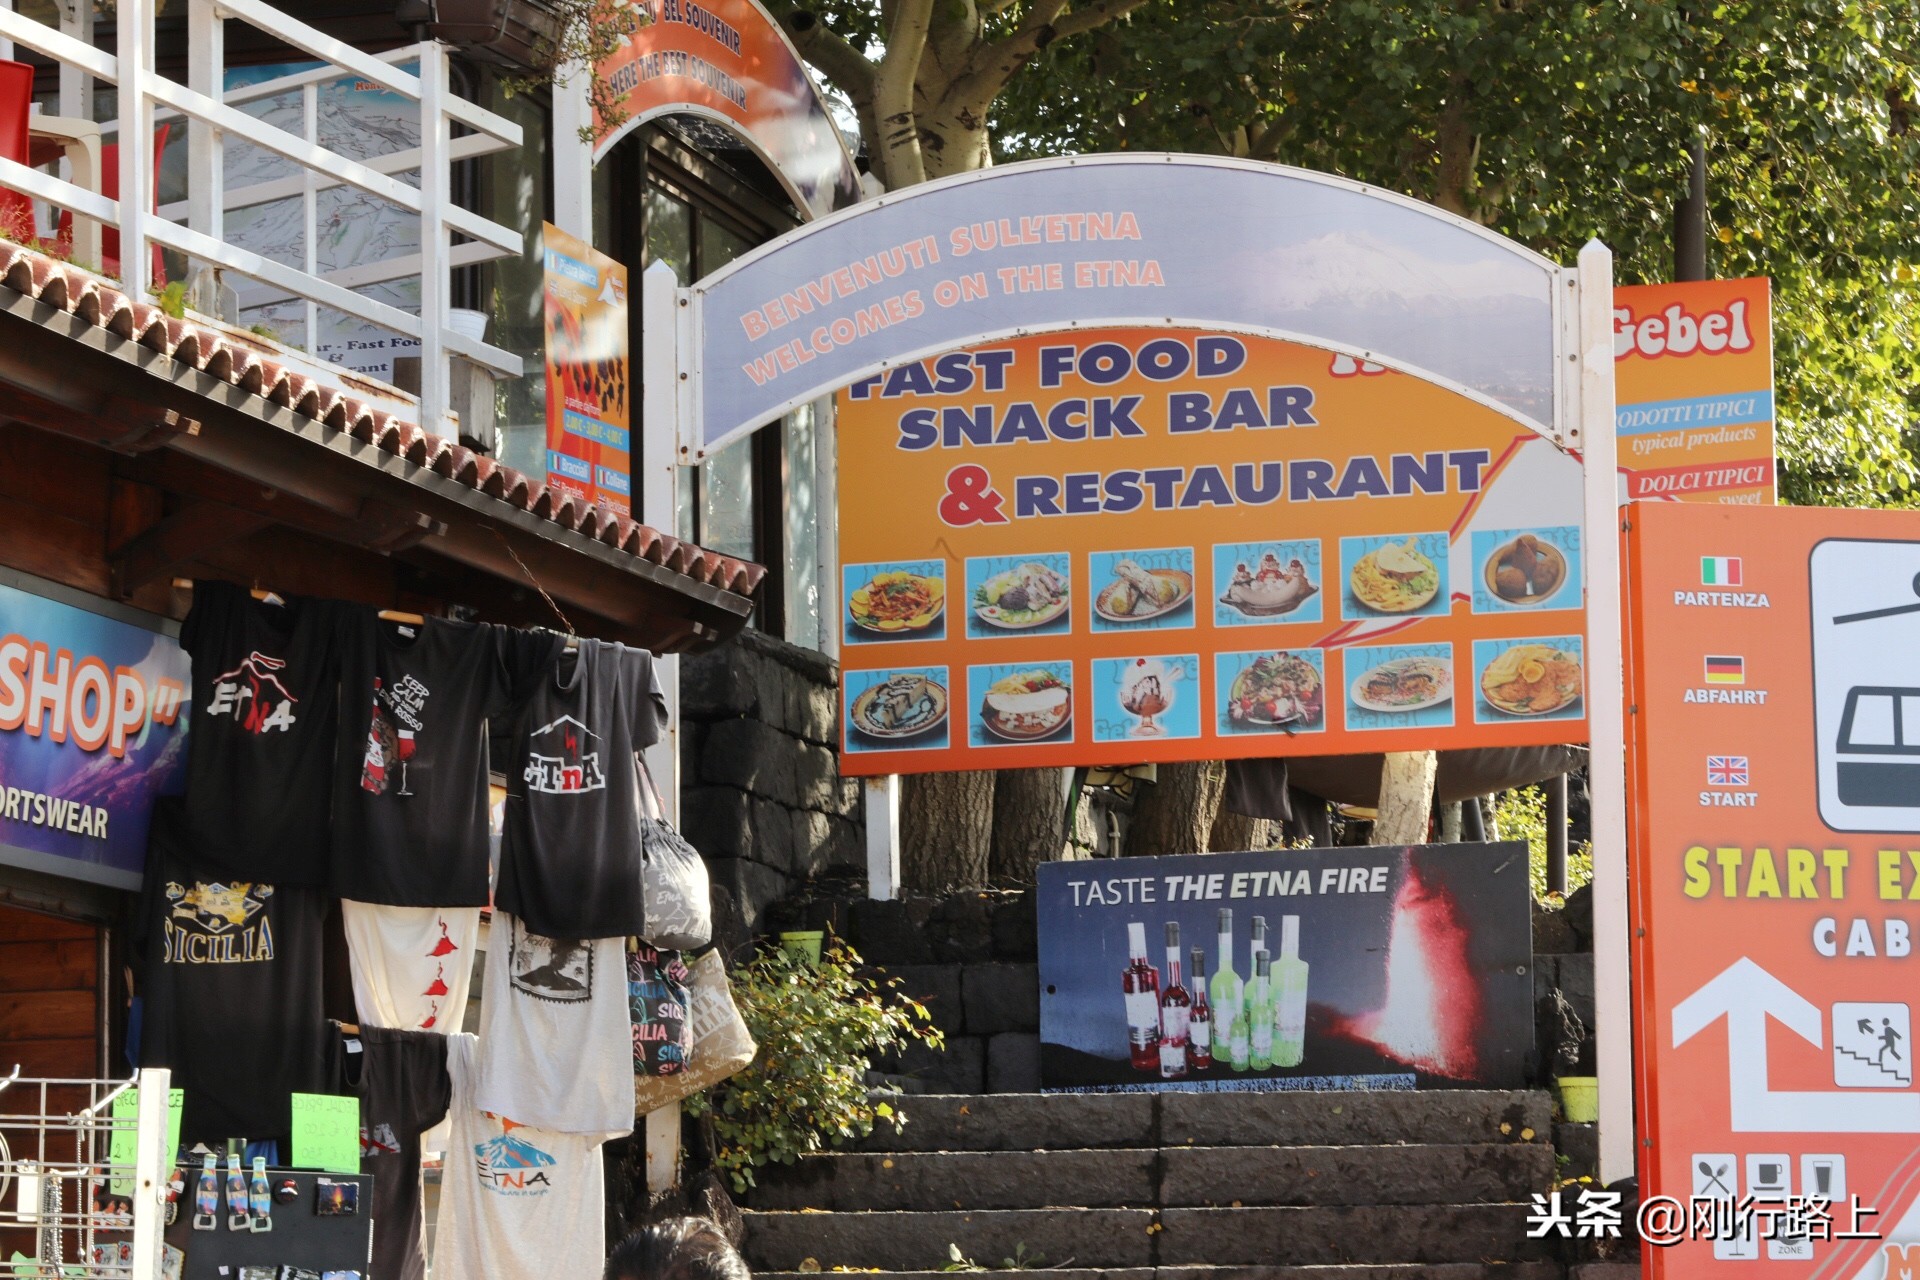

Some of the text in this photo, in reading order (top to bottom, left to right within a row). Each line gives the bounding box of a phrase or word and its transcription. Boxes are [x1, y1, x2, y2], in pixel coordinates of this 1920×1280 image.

[664, 0, 683, 23] BEL
[686, 1, 742, 58] SOUVENIR
[609, 50, 747, 112] HERE THE BEST SOUVENIR
[739, 211, 1142, 342] BENVENUTI SULL'ETNA
[741, 259, 1165, 387] WELCOMES ON THE ETNA
[347, 339, 386, 351] Fast
[391, 337, 422, 348] Foo
[1039, 336, 1247, 389] FOOD
[897, 385, 1319, 452] SNACK BAR
[1616, 398, 1756, 429] ODOTTI TIPICI
[1632, 426, 1757, 455] typical products
[562, 457, 589, 479] Bracciali
[605, 470, 628, 492] Collane
[1638, 465, 1765, 494] DOLCI TIPICI
[938, 448, 1491, 527] & RESTAURANT
[1718, 489, 1762, 505] sweet
[1674, 590, 1770, 608] PARTENZA
[393, 683, 425, 711] CALM
[402, 674, 430, 698] KEEP
[1683, 689, 1768, 705] ABFAHRT
[395, 705, 423, 731] ROSSO
[1699, 792, 1758, 807] START
[1067, 866, 1390, 908] TASTE THE ETNA FIRE
[1683, 847, 1849, 899] START
[164, 915, 274, 963] SICILIA
[1813, 917, 1911, 957] CAB
[631, 1023, 668, 1041] CILIA
[1778, 1246, 1803, 1255] ZONE
